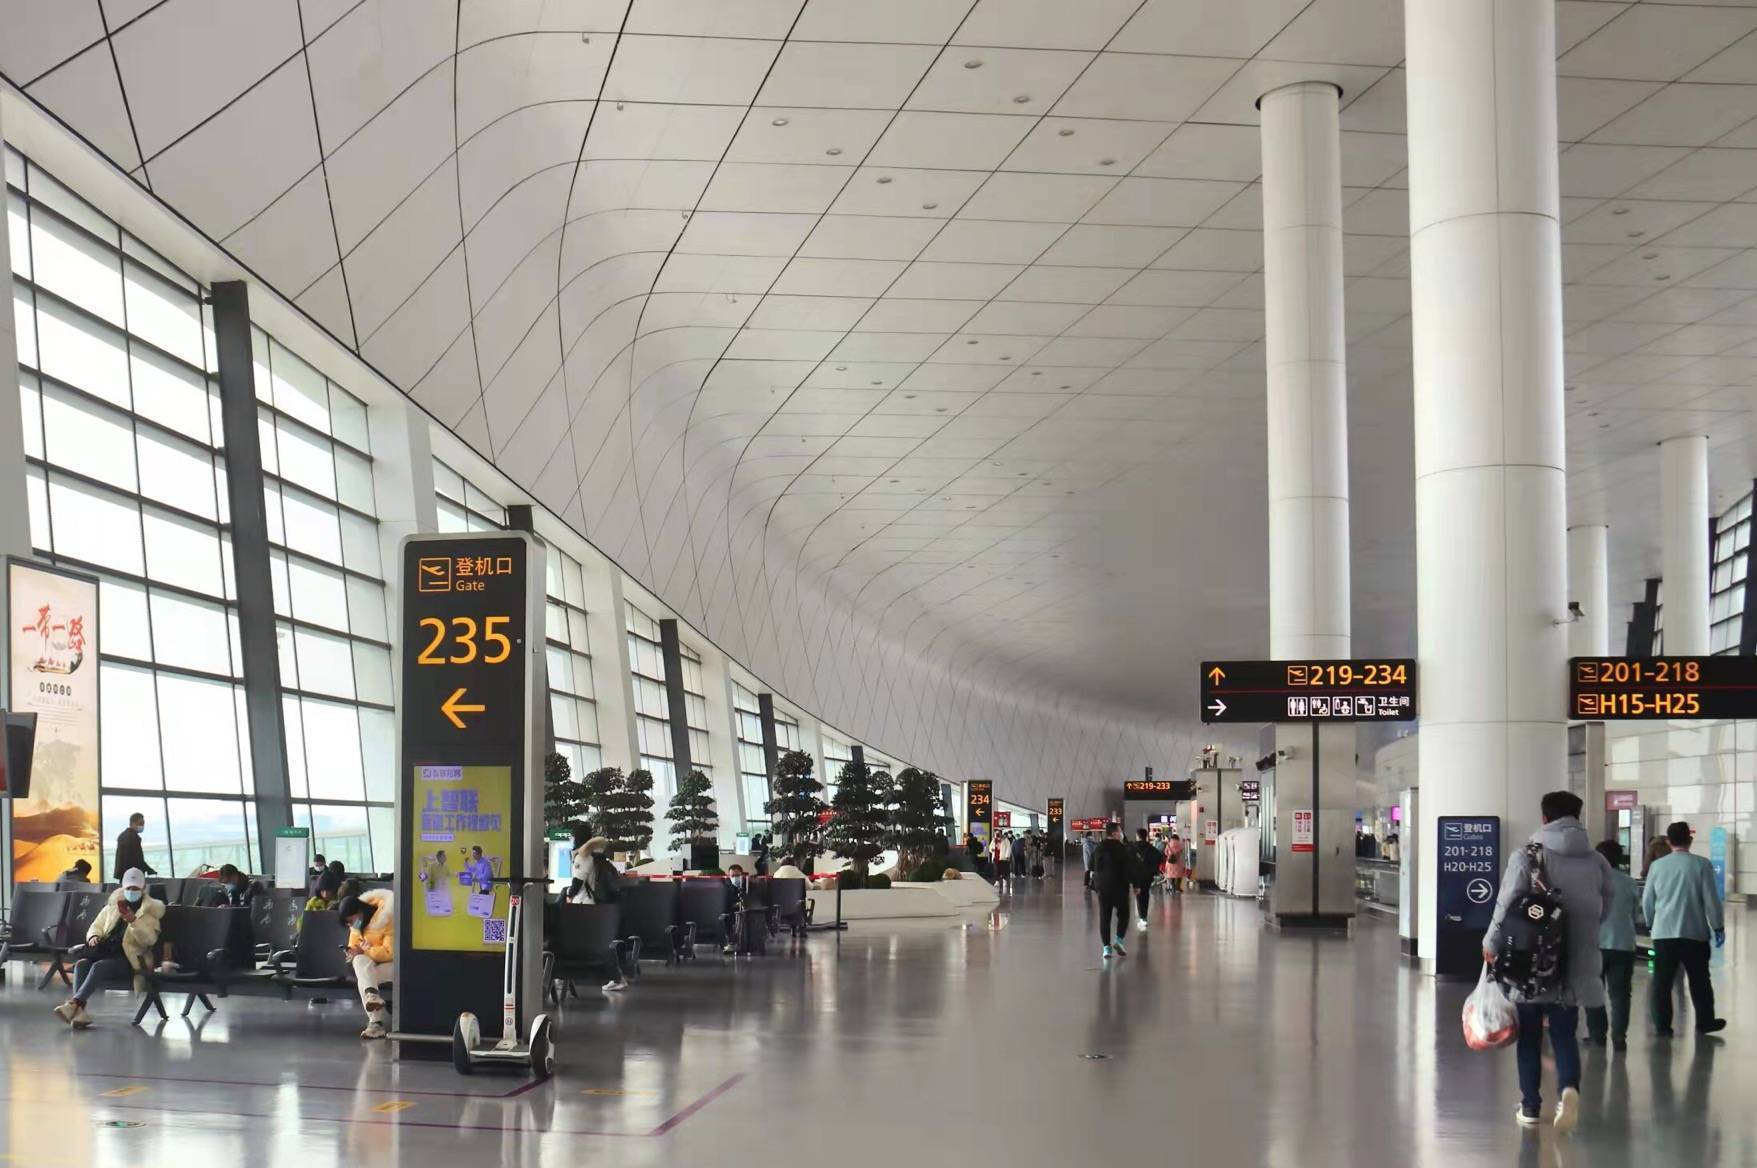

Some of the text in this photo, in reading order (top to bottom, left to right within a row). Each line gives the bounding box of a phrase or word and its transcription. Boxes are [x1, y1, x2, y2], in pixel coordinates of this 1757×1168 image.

[456, 557, 512, 576] 登机口
[456, 580, 485, 591] Gate
[418, 616, 511, 664] 235
[1310, 665, 1407, 685] 219-234
[1600, 662, 1700, 682] 201-218
[1377, 696, 1410, 707] 卫生间
[1600, 694, 1700, 714] H15-H25
[1378, 708, 1399, 716] Toilet
[1140, 782, 1171, 790] 219-233
[970, 794, 990, 805] 234
[1463, 823, 1492, 833] 登机口
[1444, 862, 1492, 872] H20-H25
